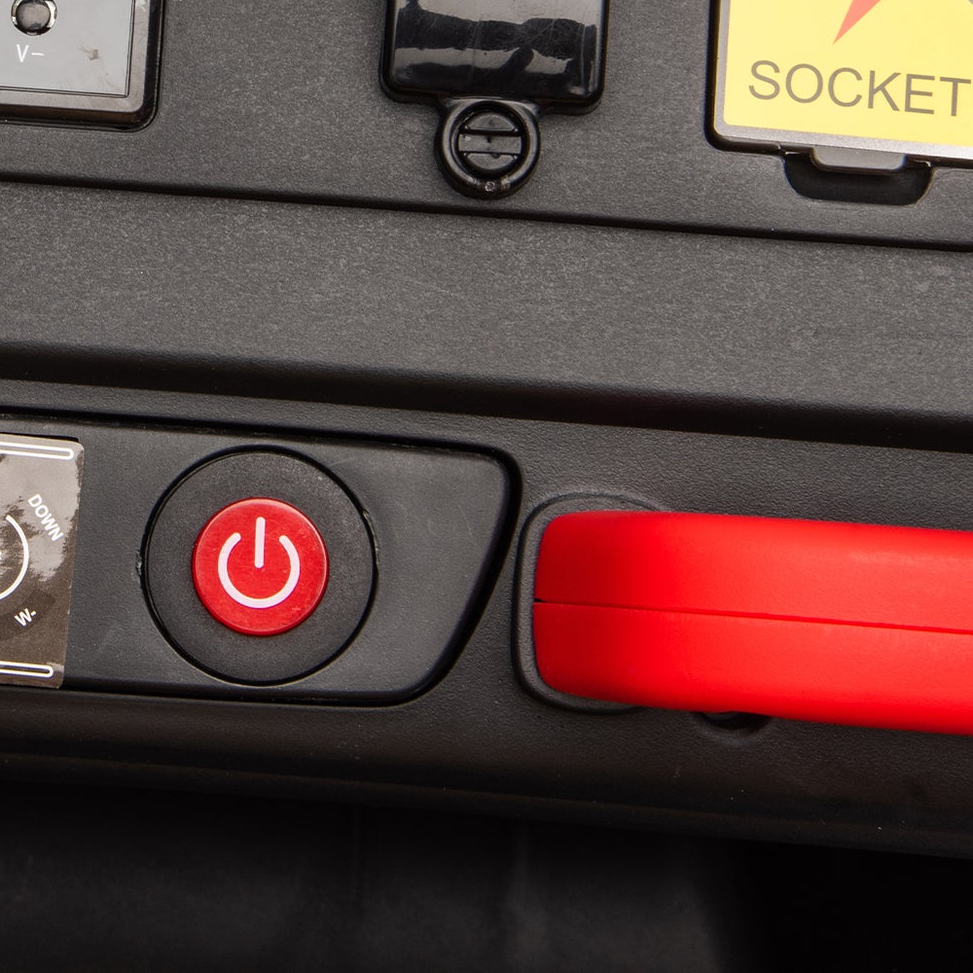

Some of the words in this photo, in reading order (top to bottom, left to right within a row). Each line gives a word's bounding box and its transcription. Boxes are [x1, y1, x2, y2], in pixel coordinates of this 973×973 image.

[748, 60, 972, 117] SOCKET
[27, 493, 64, 542] DOWN
[14, 608, 37, 627] W-
